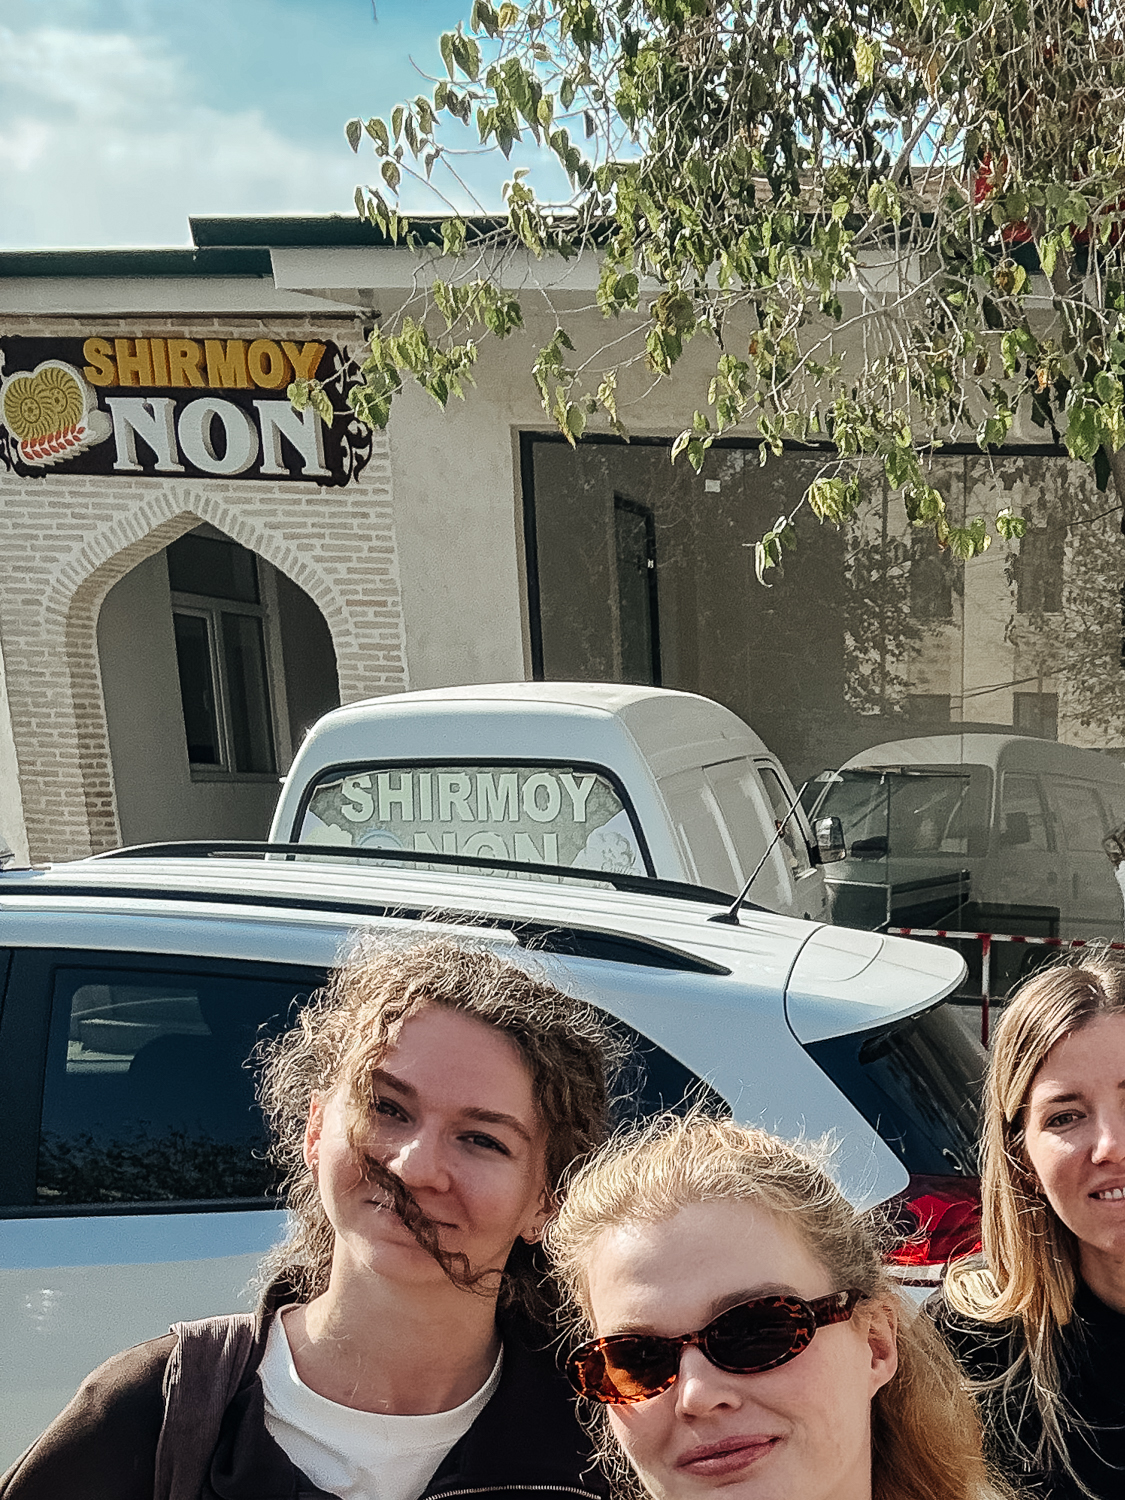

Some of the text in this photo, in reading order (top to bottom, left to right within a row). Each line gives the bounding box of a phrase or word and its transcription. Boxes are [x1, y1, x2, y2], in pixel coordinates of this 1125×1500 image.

[83, 337, 326, 389] SHIRMOY
[105, 397, 332, 477] NON
[340, 772, 598, 823] SHIRMOY
